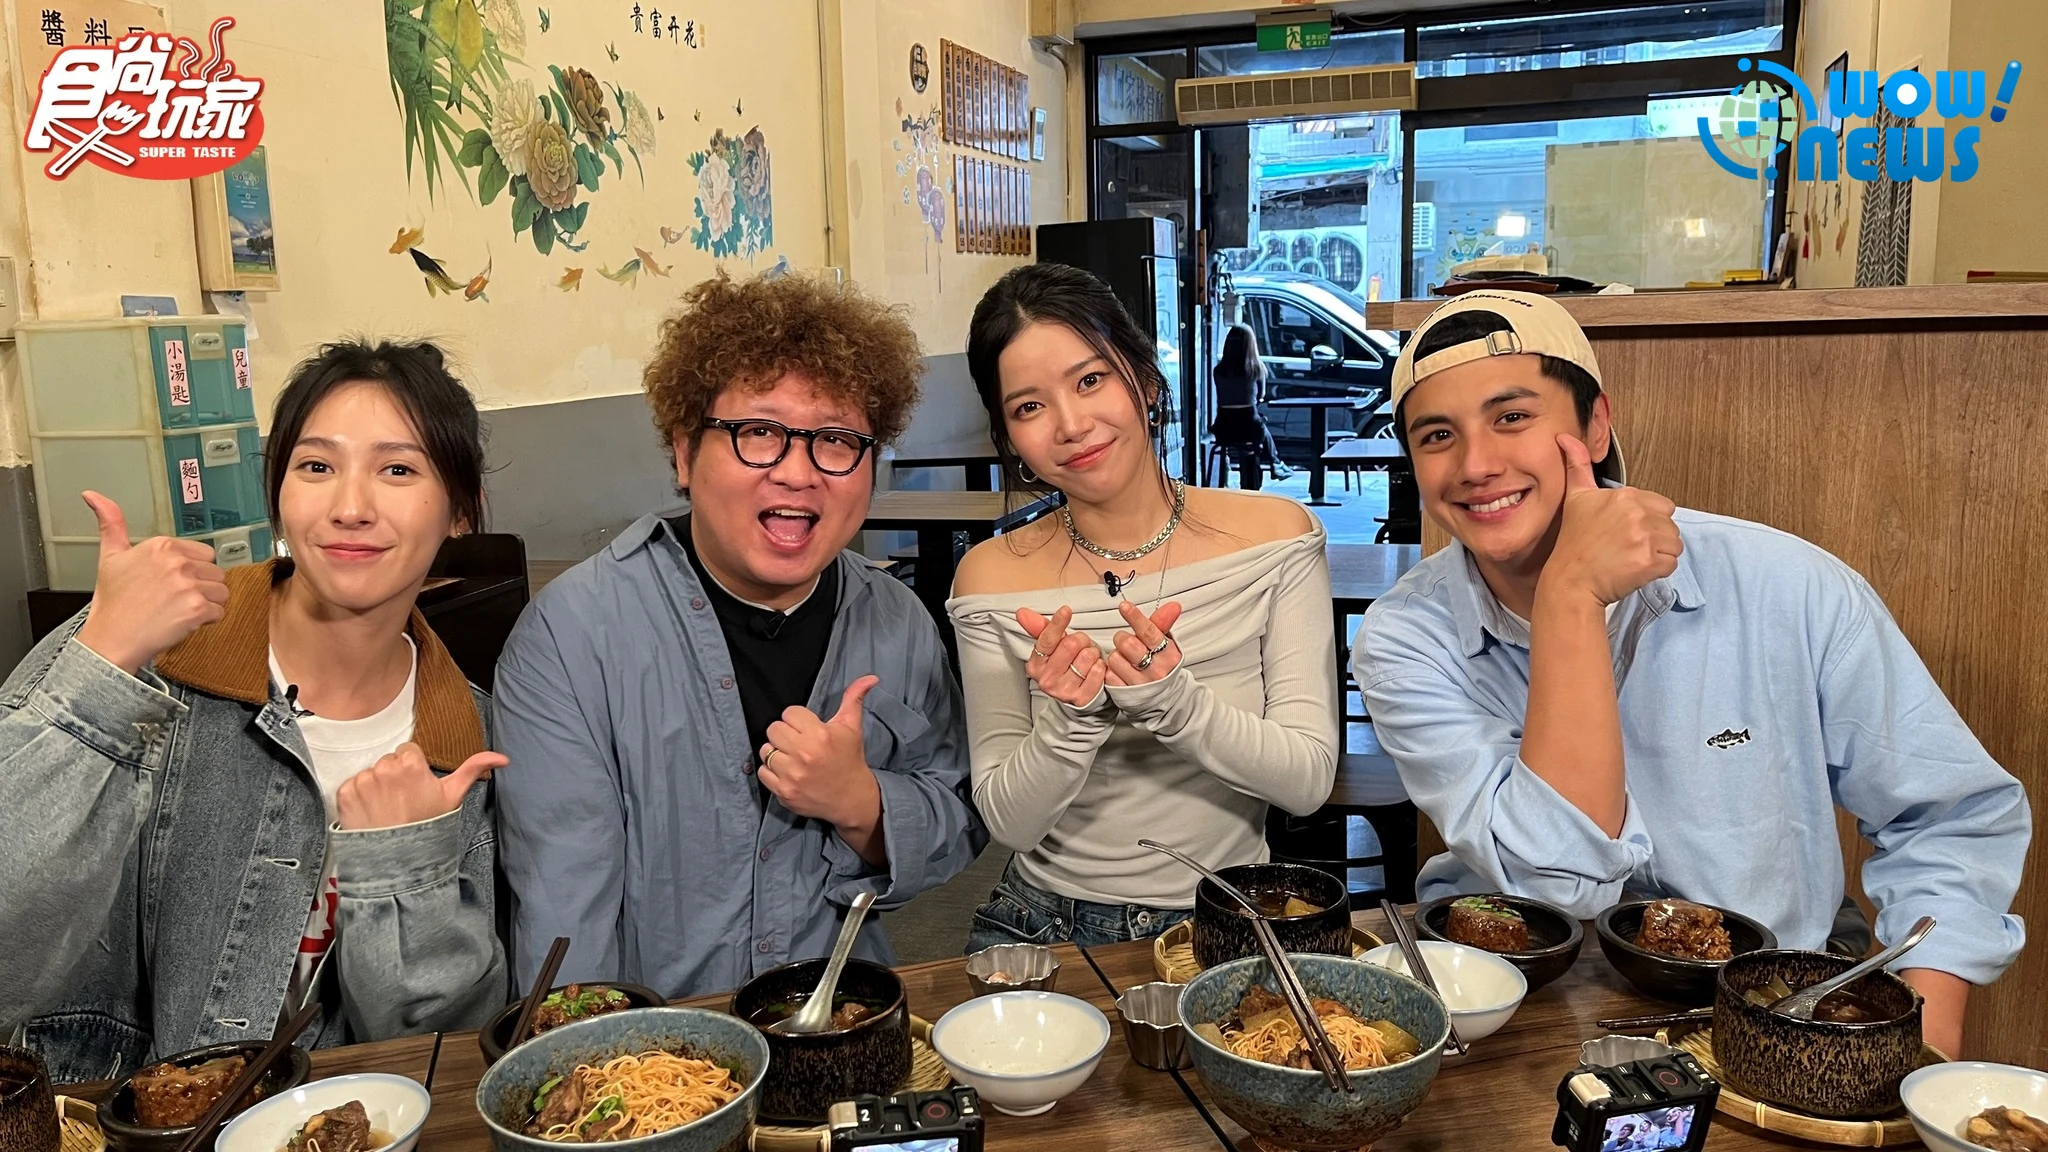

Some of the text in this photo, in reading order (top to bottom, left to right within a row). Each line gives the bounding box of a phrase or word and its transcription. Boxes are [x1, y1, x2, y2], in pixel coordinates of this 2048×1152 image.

[41, 9, 145, 47] 醬料
[167, 341, 190, 404] 小湯匙
[235, 349, 249, 390] 兒童
[181, 460, 199, 501] 麵勺
[860, 1108, 871, 1123] 2
